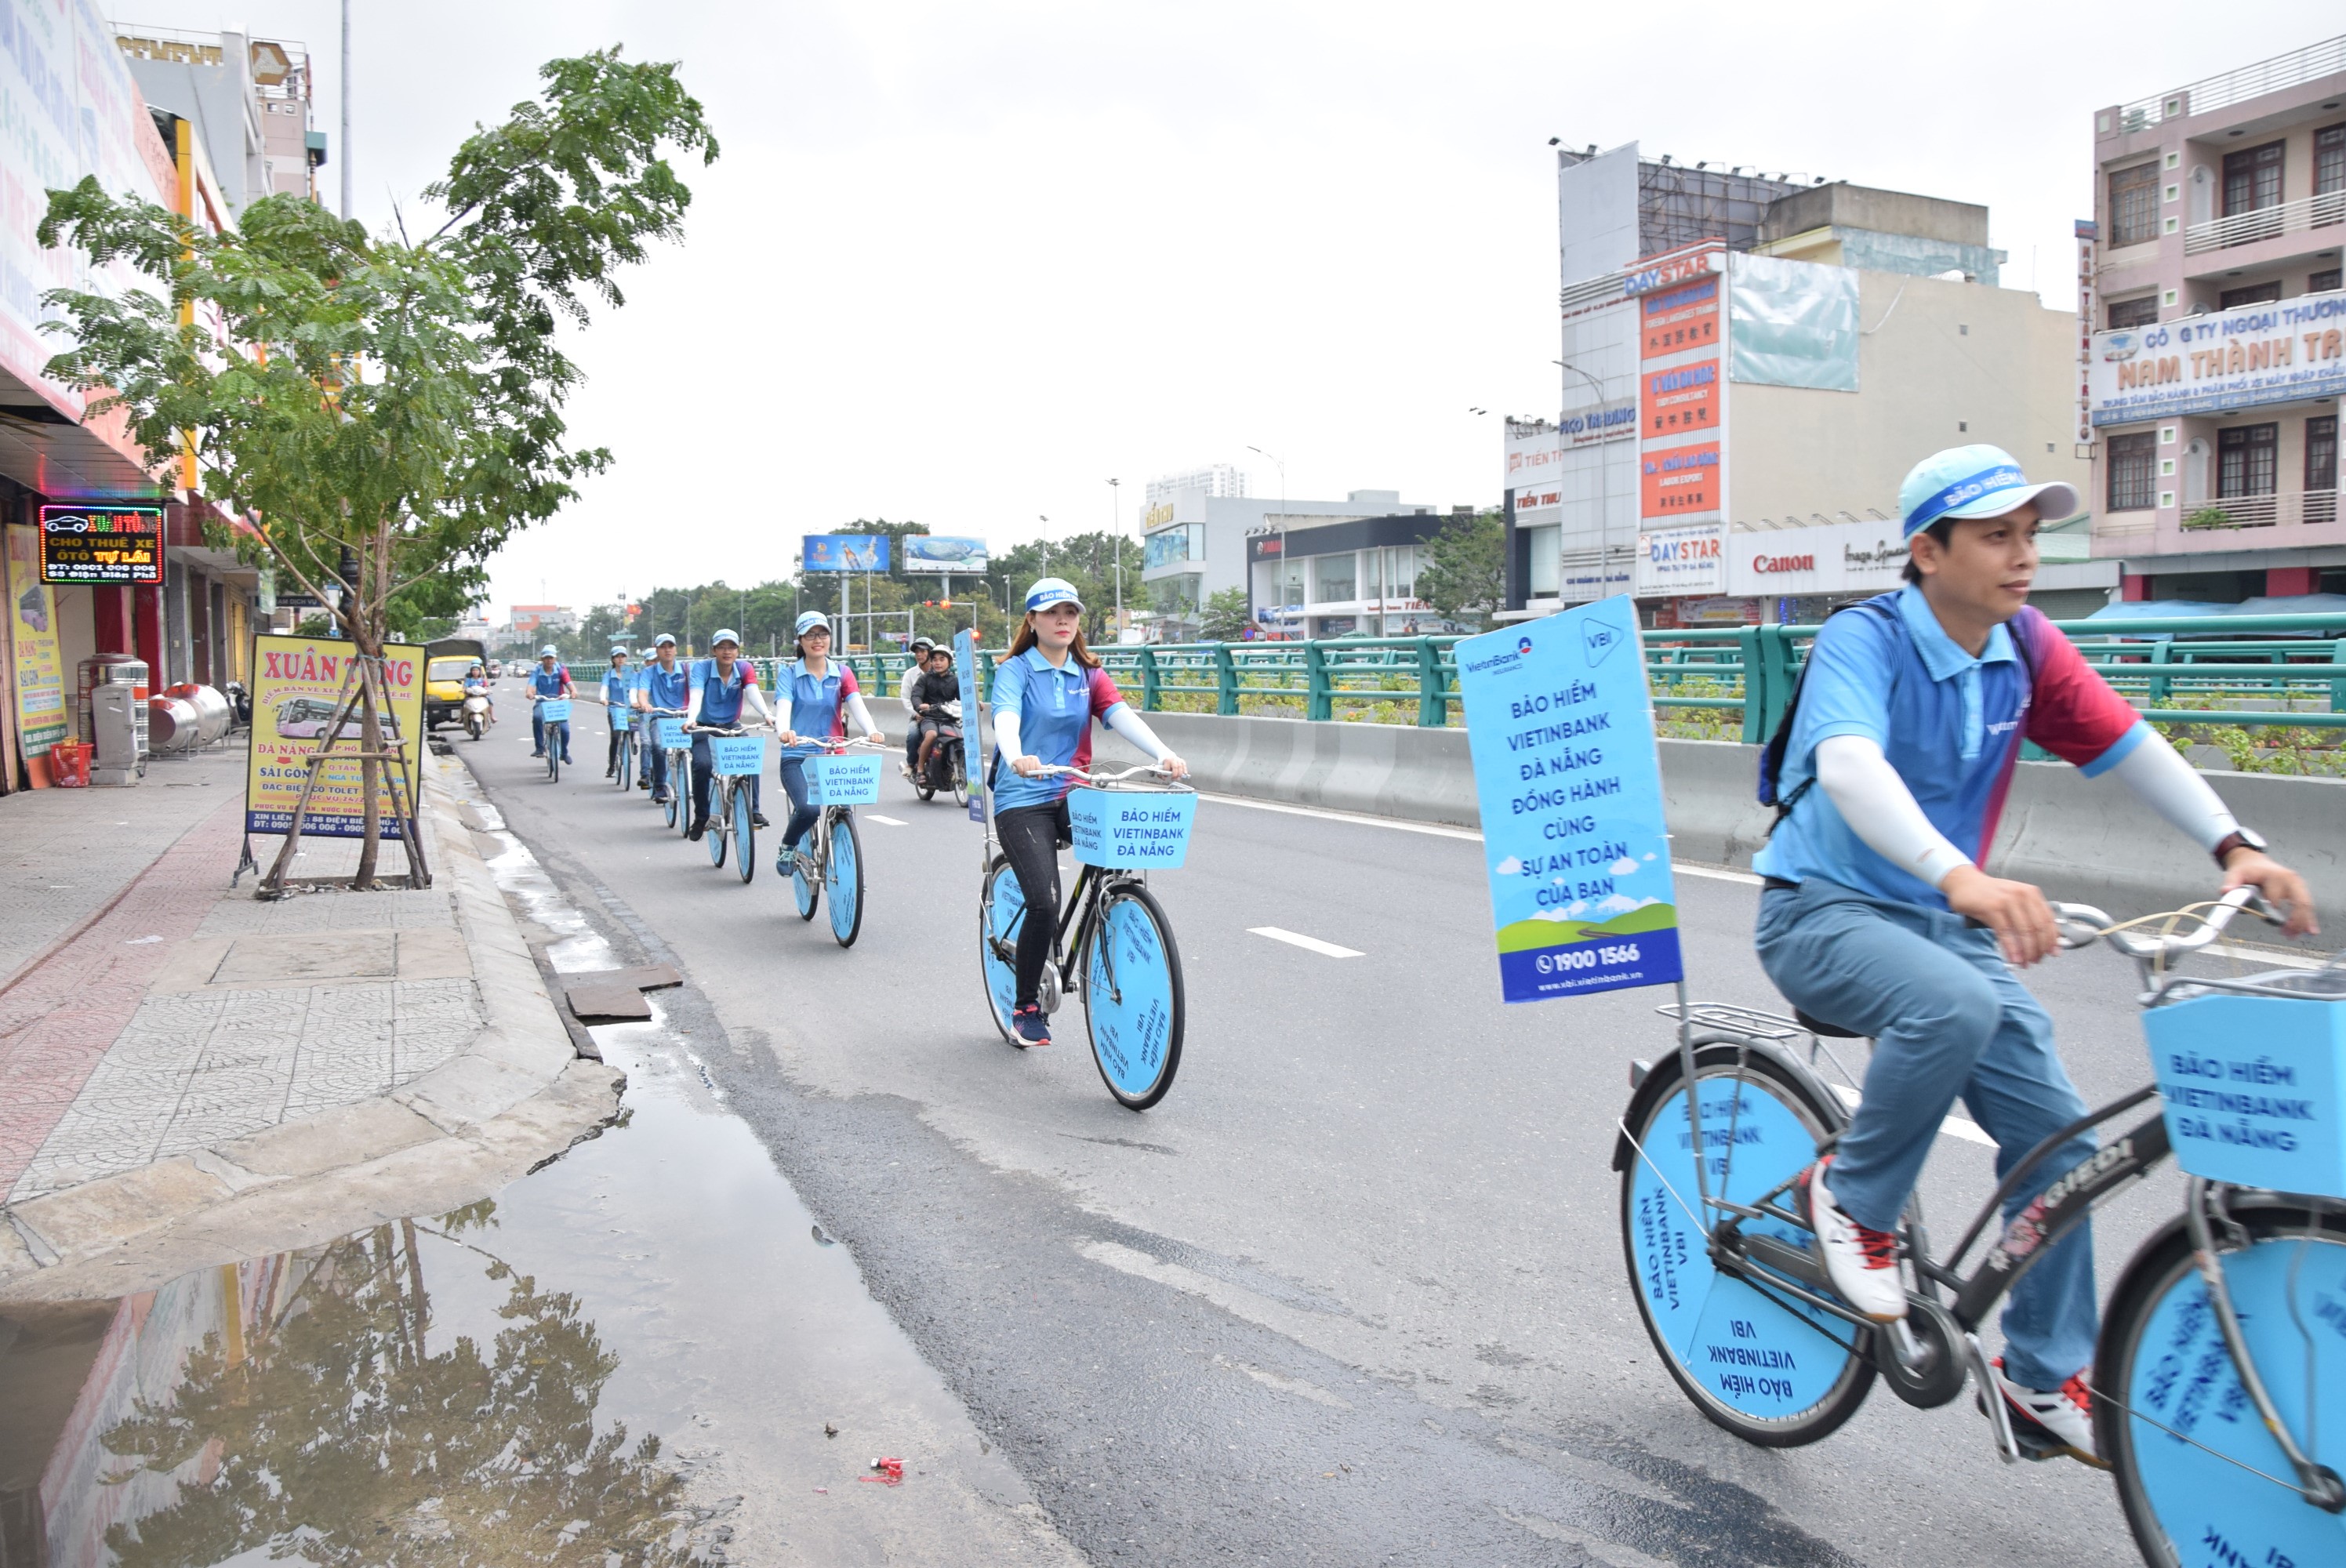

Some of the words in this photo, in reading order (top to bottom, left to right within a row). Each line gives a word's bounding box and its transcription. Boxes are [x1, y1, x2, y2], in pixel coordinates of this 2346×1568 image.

[1624, 255, 1709, 296] DAYSTAR
[2119, 355, 2181, 390] NAM
[2191, 336, 2293, 379] THÀNH
[49, 537, 83, 547] CHO
[88, 536, 129, 548] THUÊ
[135, 539, 155, 548] XE
[1651, 539, 1721, 562] DAYSTAR
[56, 550, 90, 561] ÔTÔ
[1752, 554, 1814, 574] Canon
[1039, 592, 1055, 601] BẢO
[1587, 631, 1613, 649] VBI
[264, 646, 338, 682] XUÂN
[344, 656, 413, 687] TNG
[1510, 693, 1549, 719] BẢO
[1552, 678, 1597, 709] HIỂM
[1506, 711, 1611, 752] VIETINBANK
[721, 753, 760, 761] VIETINBANK
[724, 743, 739, 753] BẢO
[740, 742, 757, 753] HIỂM
[829, 764, 848, 775] BẢO
[850, 764, 870, 775] HIỂM
[1520, 756, 1547, 781] ĐÀ
[1549, 746, 1603, 775] NẴNG
[329, 786, 359, 795] TOLET
[825, 777, 874, 786] VIETINBANK
[829, 787, 842, 797] ĐÀ
[844, 786, 869, 797] NẴNG
[1511, 788, 1566, 815] ĐỒNG
[1570, 775, 1622, 803] HÀNH
[271, 812, 292, 821] LIÊN
[325, 816, 347, 826] ĐIỆN
[319, 823, 336, 832] 006
[1083, 812, 1098, 825] HIỂM
[1121, 808, 1149, 822] BẢO
[1152, 807, 1181, 822] HIỂM
[1543, 815, 1596, 840] CÙNG
[1113, 827, 1185, 840] VIETINBANK
[1117, 842, 1136, 856] ĐÀ
[1139, 840, 1175, 856] NẴNG
[1520, 855, 1545, 880] SỰ
[1547, 851, 1574, 873] AN
[1575, 840, 1629, 867] TOÀN
[1535, 882, 1574, 906] CỦA
[1577, 877, 1615, 902] BẠN
[1552, 949, 1597, 971] 1900
[1597, 942, 1641, 965] 1566
[1109, 1023, 1120, 1043] VBI
[1136, 1012, 1146, 1033] VBI
[1140, 997, 1160, 1065] VIETINBANK
[1155, 1011, 1167, 1040] BẢO
[1099, 1022, 1130, 1071] VIETINBANK
[1149, 1038, 1160, 1069] HIỂM
[1113, 1058, 1126, 1080] BẢO
[2170, 1049, 2225, 1080] BẢO
[2226, 1054, 2299, 1088] HIỂM
[2161, 1082, 2318, 1122] VIETINBANK
[2177, 1113, 2216, 1142] ĐÀ
[2216, 1116, 2301, 1152] NẴNG
[1638, 1196, 1657, 1248] HIỂM
[1654, 1186, 1681, 1312] VIETINBANK
[1674, 1230, 1689, 1267] VBI
[1648, 1254, 1664, 1301] BẢO
[1730, 1319, 1757, 1339] VBI
[1707, 1345, 1797, 1371] VIETINBANK
[1720, 1373, 1756, 1400] HIỂM
[1758, 1377, 1794, 1403] BẢO
